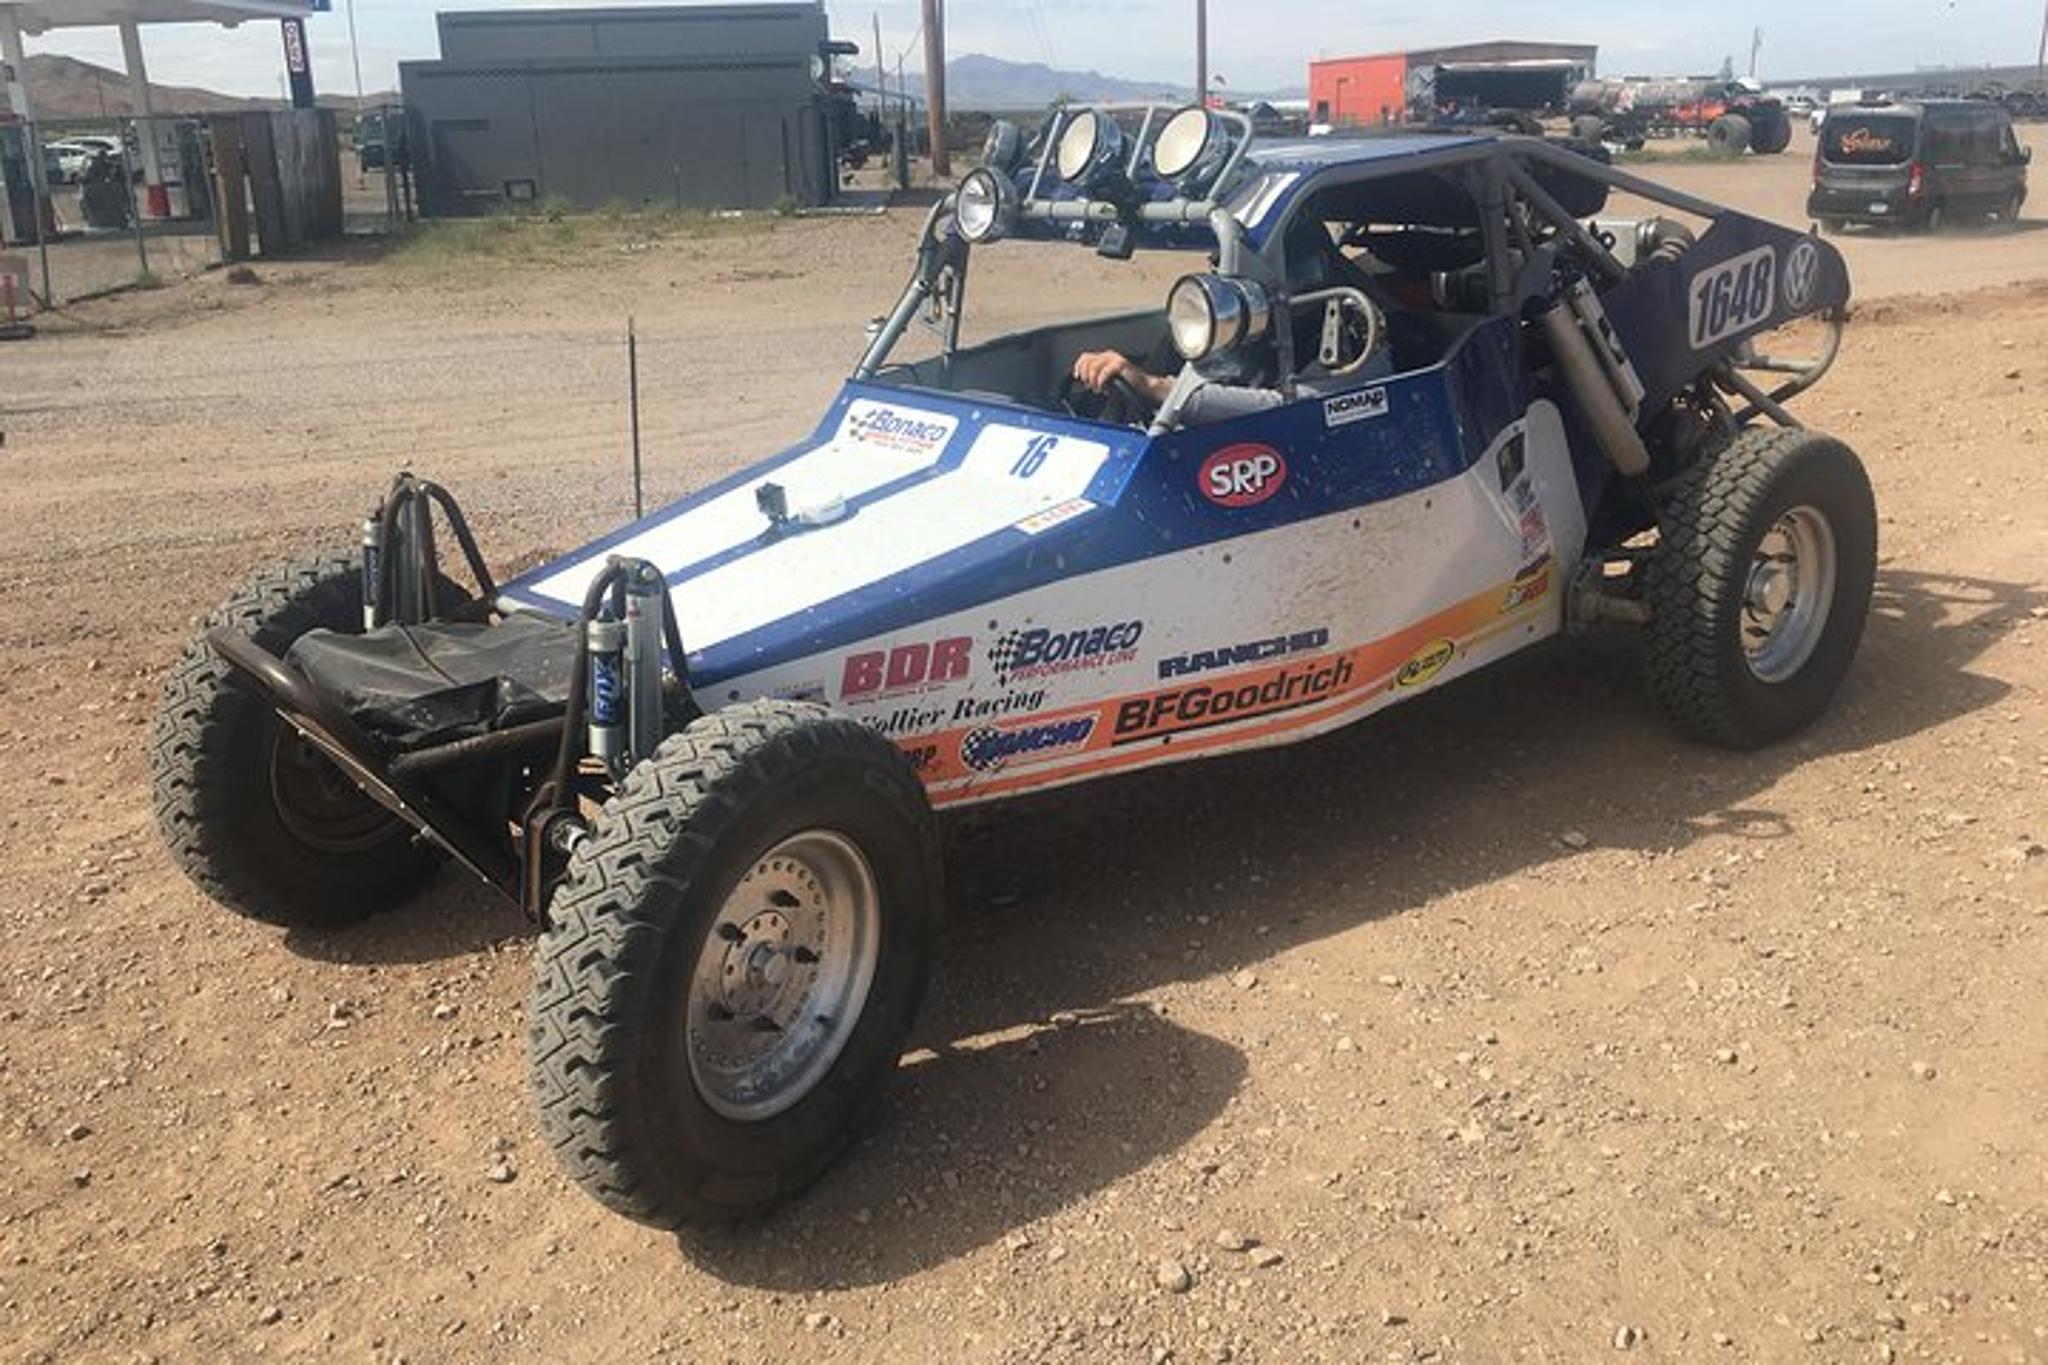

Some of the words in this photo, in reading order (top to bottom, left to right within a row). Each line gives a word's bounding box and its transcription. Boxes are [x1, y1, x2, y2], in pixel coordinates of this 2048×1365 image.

[1697, 262, 1772, 343] 1648
[867, 409, 948, 441] Bonaco
[1010, 435, 1059, 478] 16
[1209, 454, 1279, 496] SRP
[840, 636, 974, 699] BDR
[1010, 620, 1144, 668] Bonaco
[1158, 627, 1329, 679] RANCHO
[952, 690, 1045, 720] Racing
[1113, 656, 1353, 736] BFGoodrich
